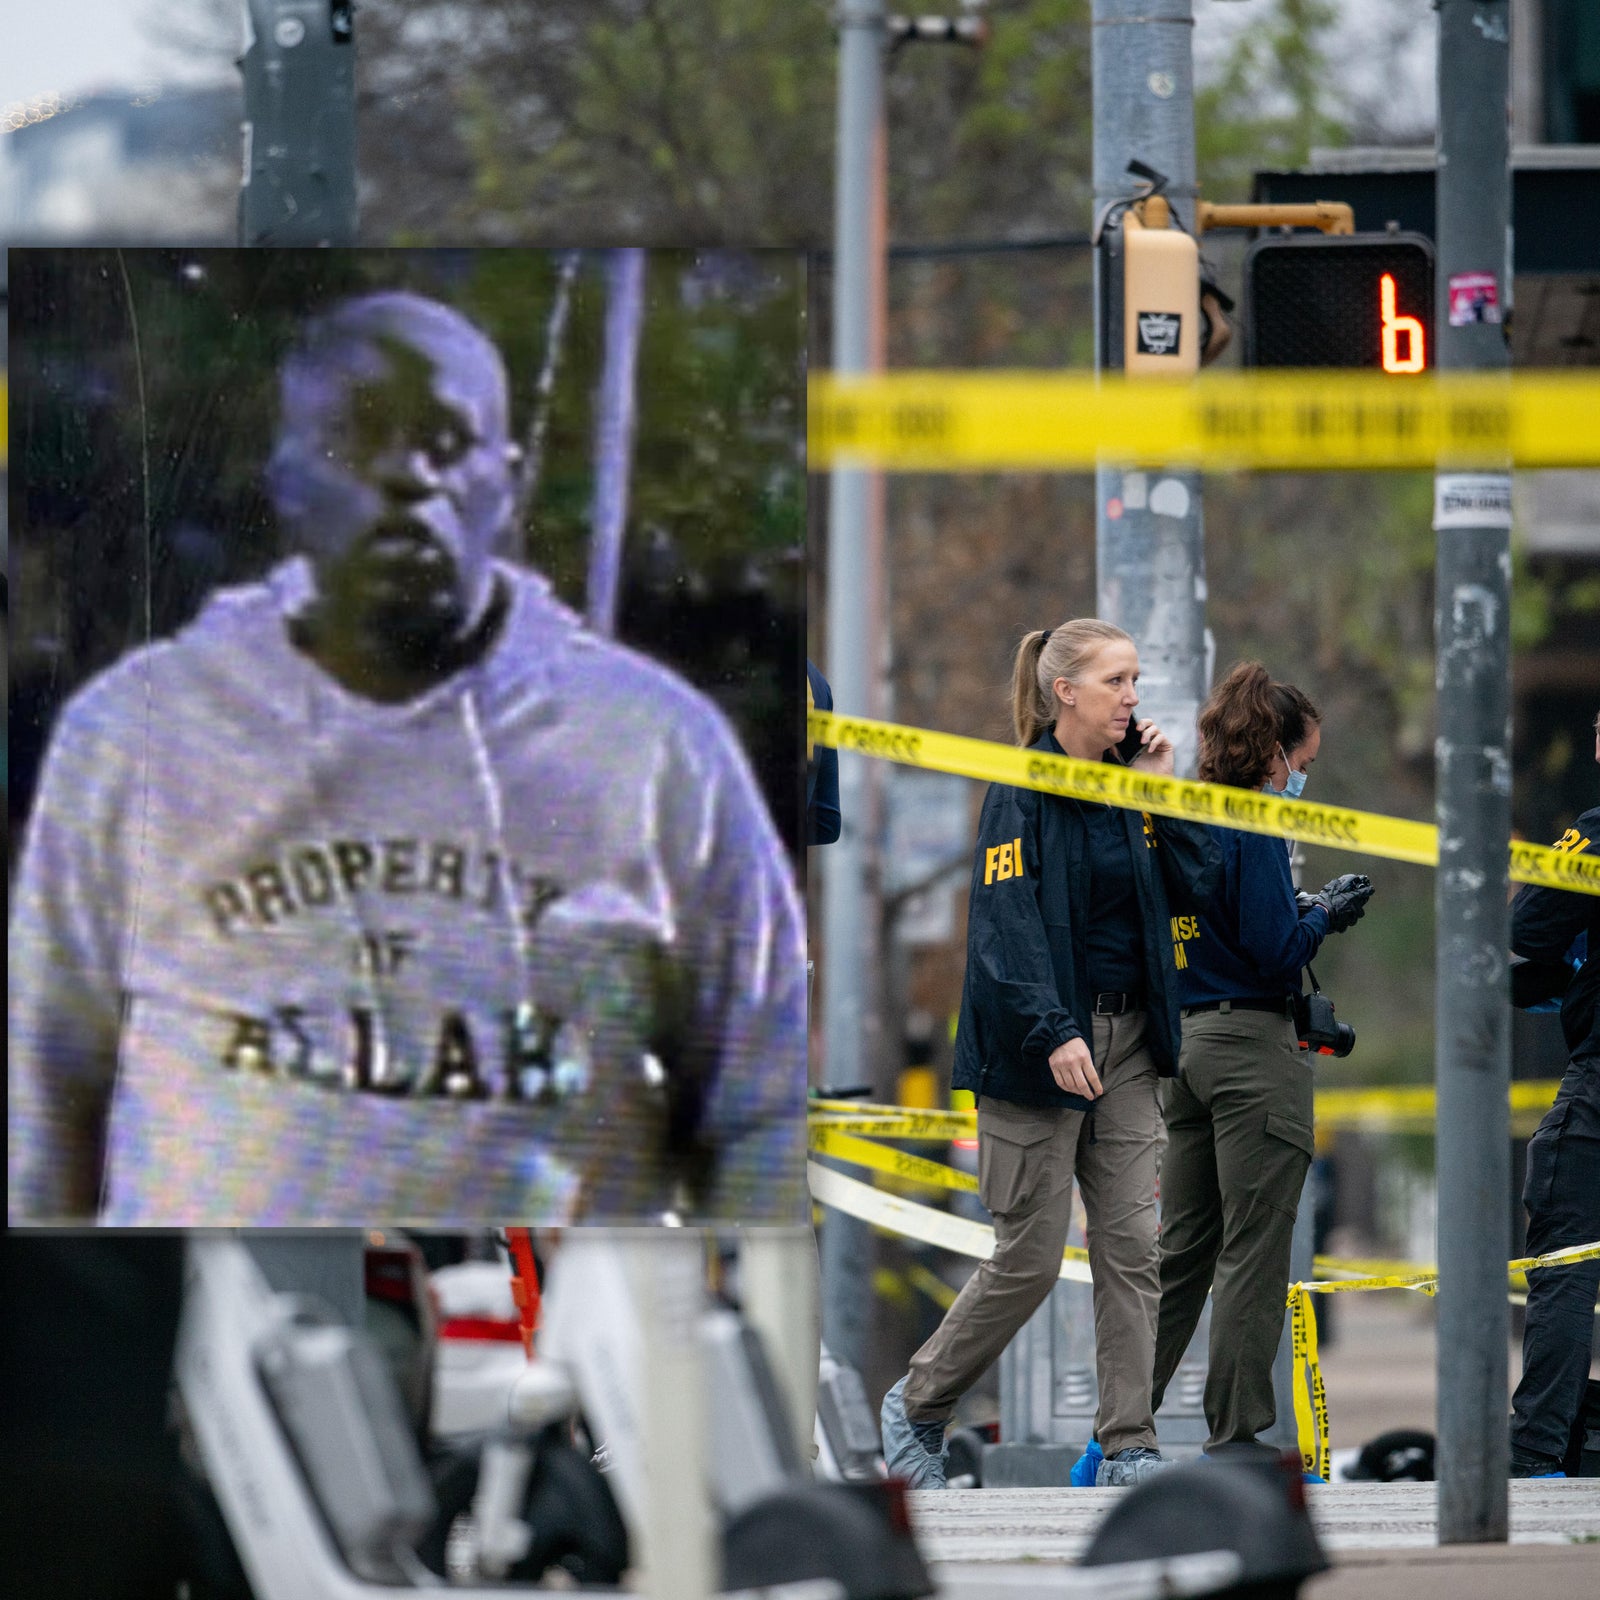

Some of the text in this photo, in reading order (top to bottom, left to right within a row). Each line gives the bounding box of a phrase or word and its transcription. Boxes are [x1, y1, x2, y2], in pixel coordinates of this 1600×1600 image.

[838, 724, 922, 757] CROSS
[1028, 757, 1358, 843] POLICE LINE DO NOT CROSS
[205, 838, 562, 935] PROPERTY
[984, 837, 1024, 886] FBI
